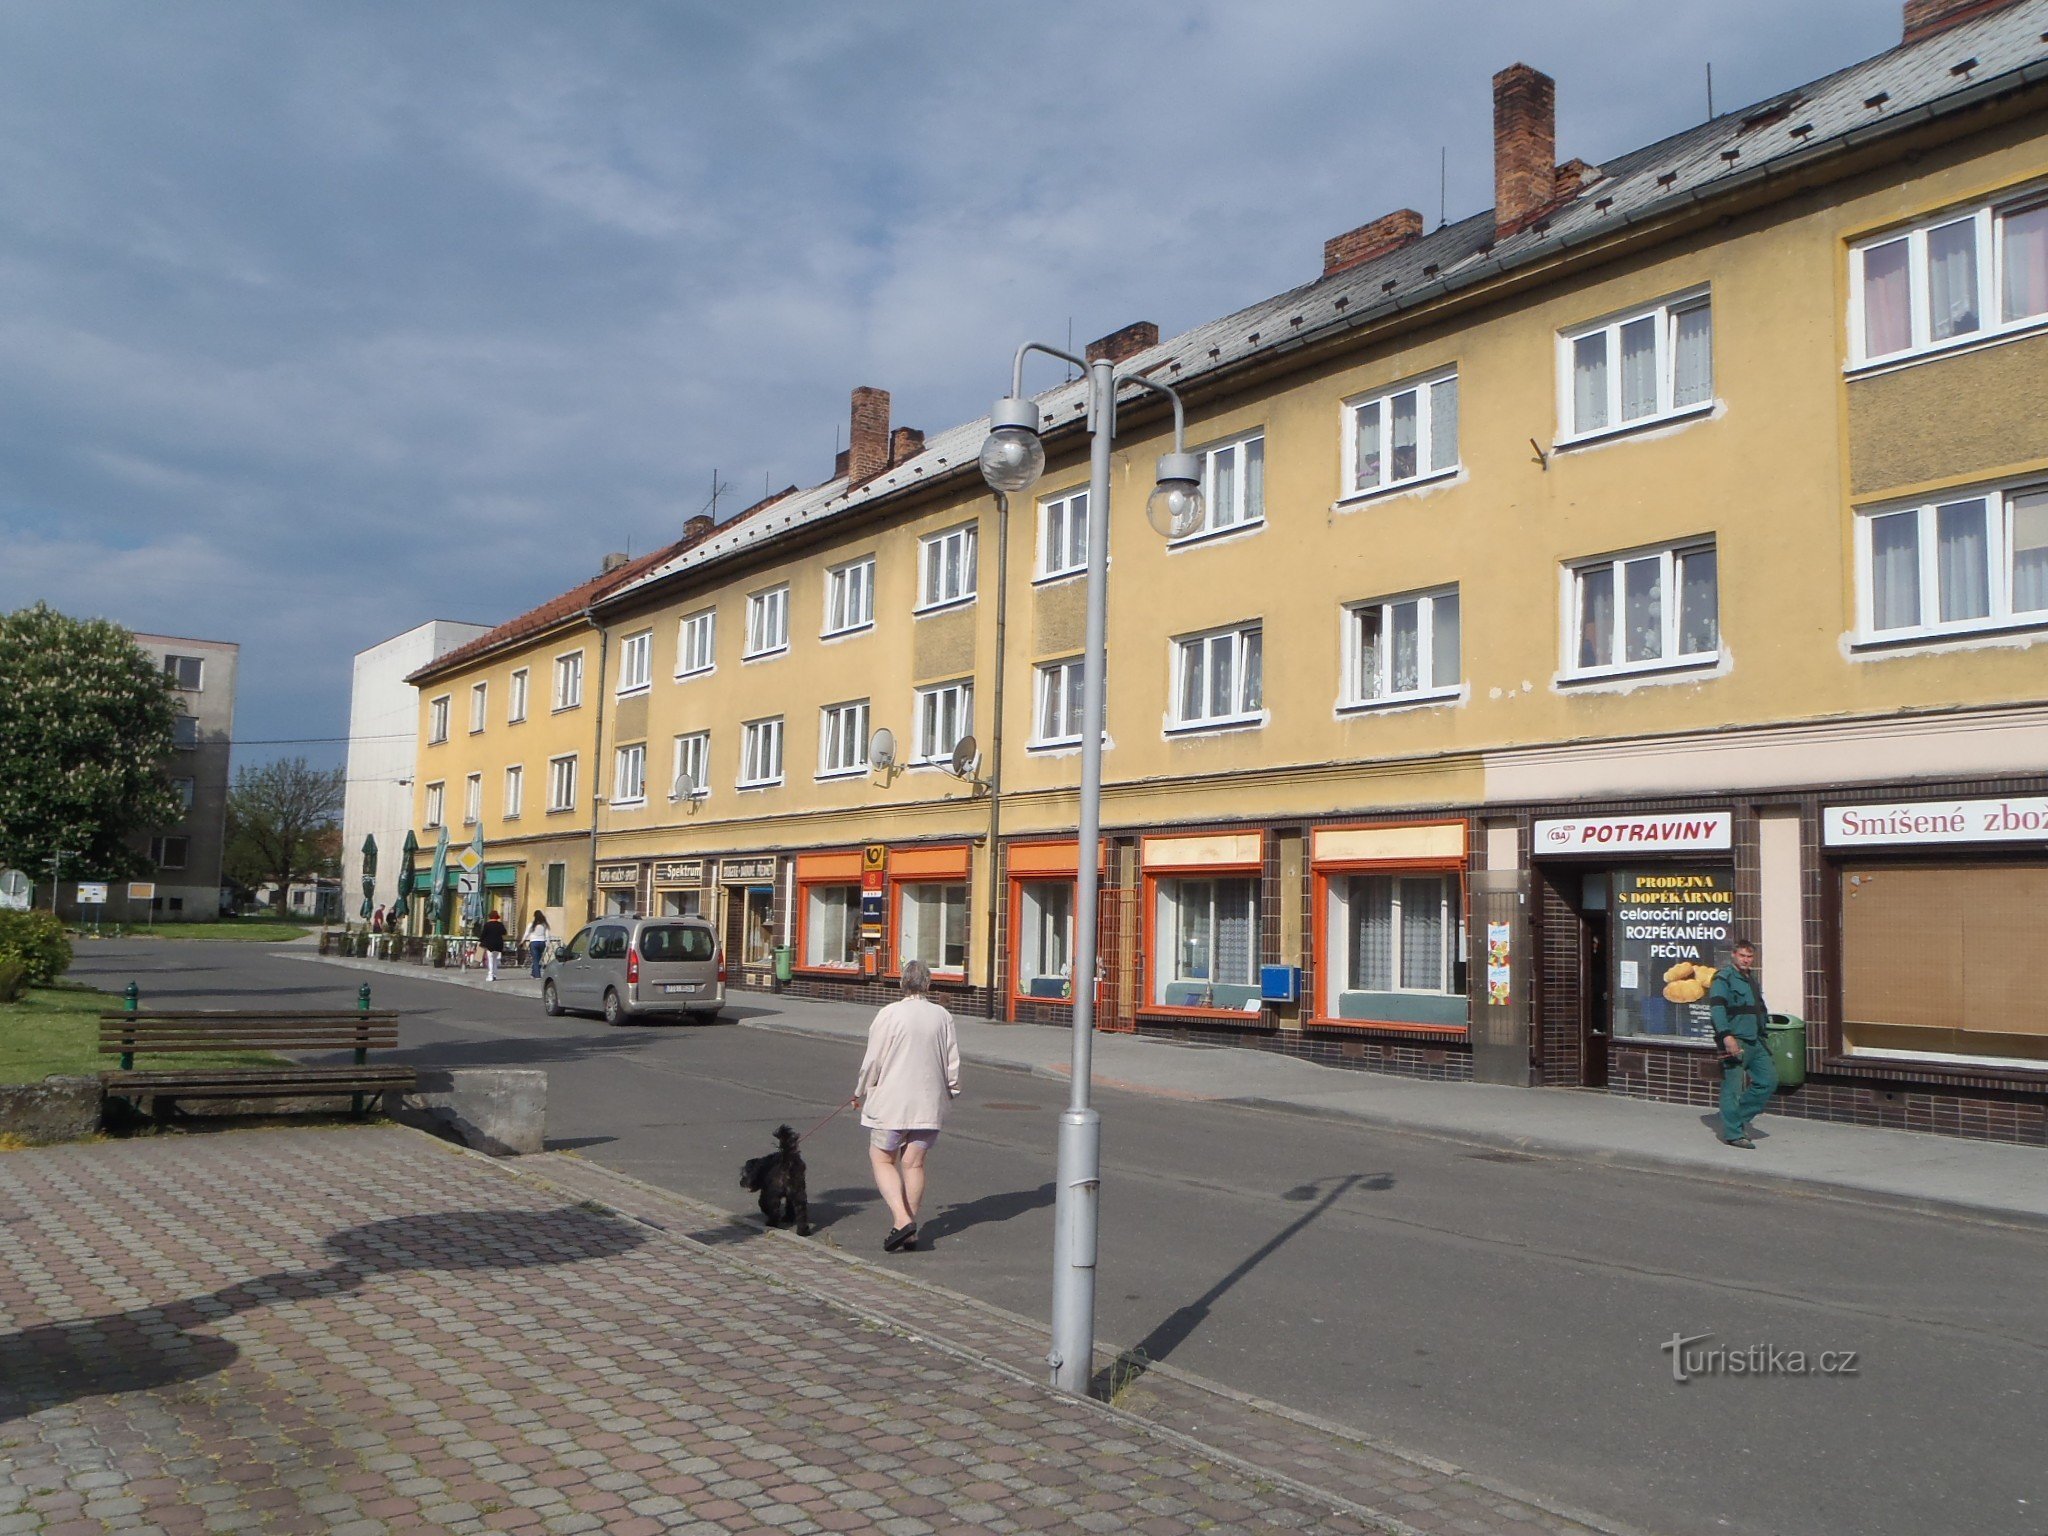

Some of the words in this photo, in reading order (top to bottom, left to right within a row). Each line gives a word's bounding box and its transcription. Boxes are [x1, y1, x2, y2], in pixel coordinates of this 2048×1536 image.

[1842, 806, 1965, 836] Smíšené
[1581, 821, 1718, 843] POTRAVINY
[667, 864, 701, 880] Spektrum
[1635, 875, 1714, 888] PRODEJNA
[1618, 892, 1627, 903] S
[1630, 889, 1733, 904] DOPÉKÁRNOU
[1620, 907, 1684, 921] celoroční
[1686, 907, 1732, 924] prodej
[1626, 923, 1727, 940] ROZPÉKANÉHO
[1650, 942, 1700, 958] PEČIVA
